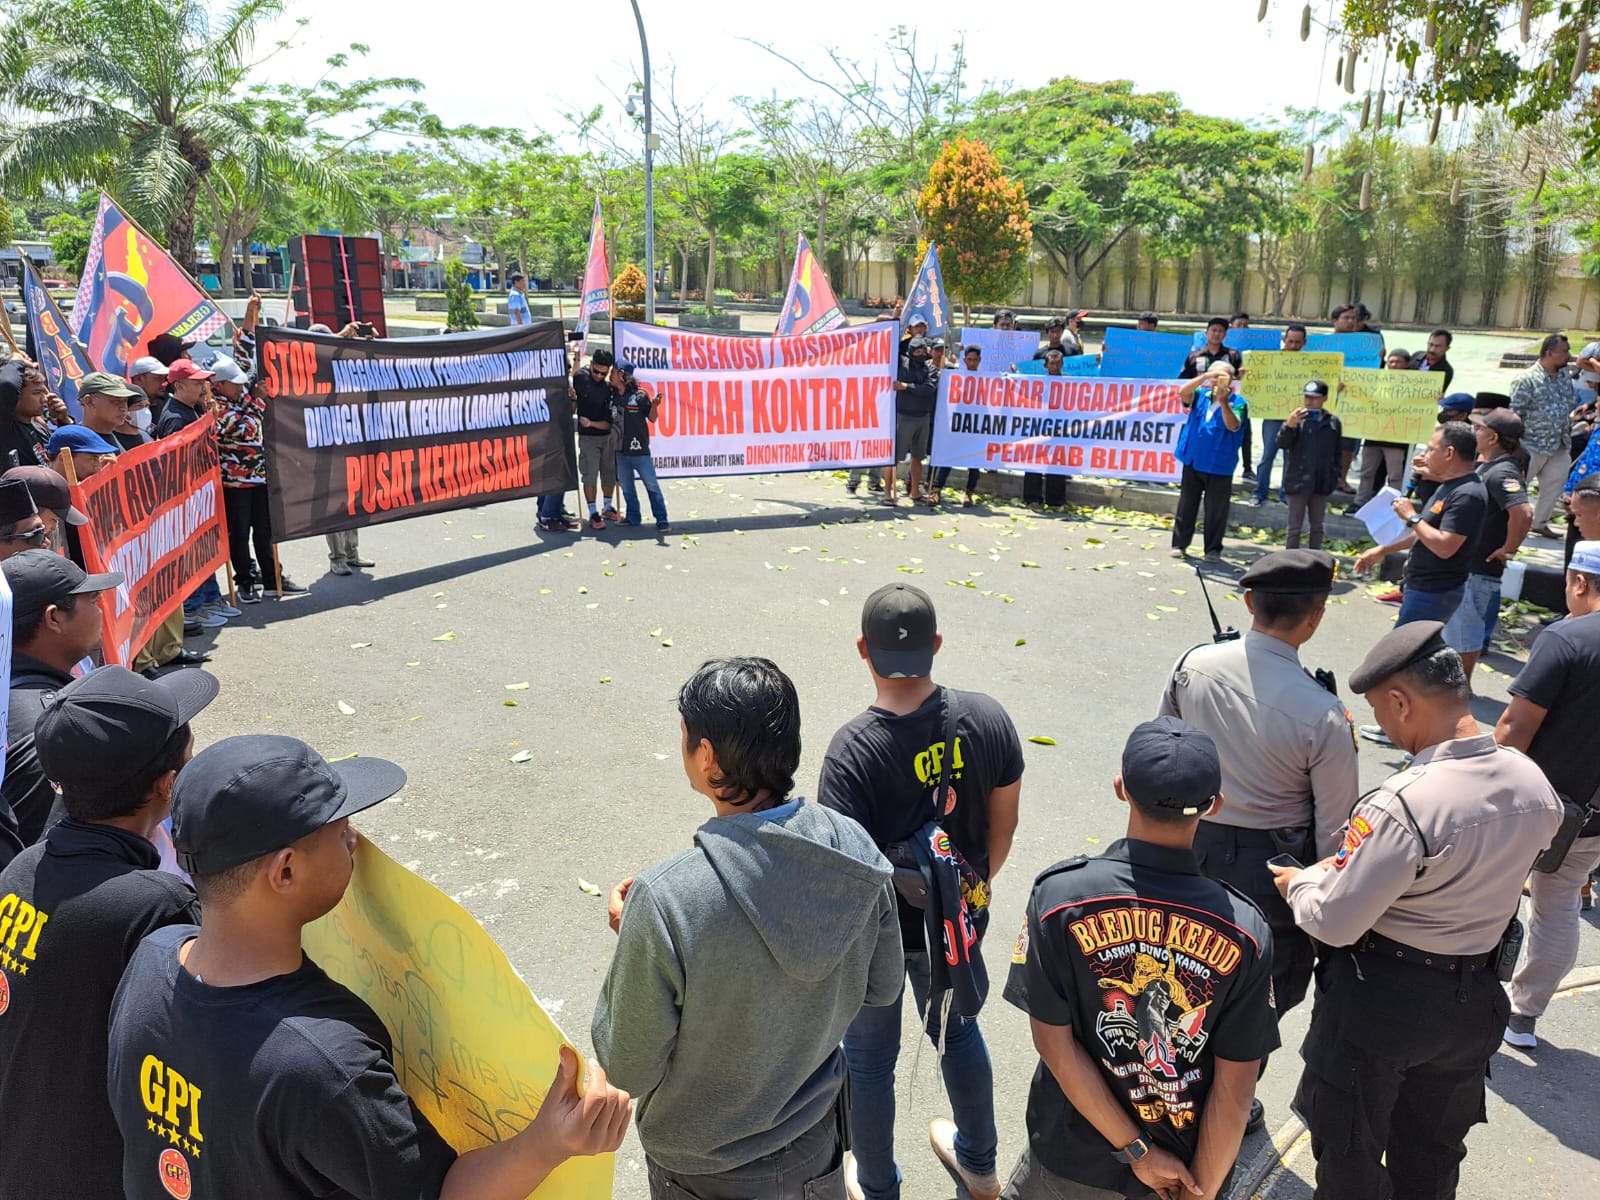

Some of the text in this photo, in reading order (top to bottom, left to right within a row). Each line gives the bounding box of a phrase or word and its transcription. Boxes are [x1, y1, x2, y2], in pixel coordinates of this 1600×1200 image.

[332, 359, 399, 393] ANGGARAN
[395, 356, 436, 389] UNTUK
[433, 352, 509, 386] PEMBANGUNAN
[508, 350, 541, 378] RUMAH
[540, 348, 566, 377] SAKIT
[623, 346, 668, 369] SEGERA
[670, 333, 764, 370] EKSEKUSI
[780, 330, 892, 367] KOSONGKAN
[948, 375, 1043, 410] BONGKAR
[1049, 381, 1133, 413] DUGAAN
[304, 388, 550, 448] DIDUGA HANYA MENJADI LADANG BISNIS
[951, 412, 1175, 444] DALAM PENGELOLAAN ASET
[1342, 414, 1422, 441] PDAM
[346, 435, 531, 515] PUSAT KEKUASAAN
[652, 455, 680, 469] ABATAN
[681, 455, 702, 468] WAKIL
[703, 455, 728, 468] BUPATI
[728, 453, 745, 466] YANG
[745, 443, 806, 465] DIKONTRAK
[807, 442, 828, 463] 294
[829, 441, 852, 462] JUTA
[860, 439, 893, 459] TAHUN
[985, 442, 1176, 474] PEMKAB BLITAR
[124, 447, 187, 526] RUMAH
[149, 504, 185, 569] WAKIL
[914, 737, 964, 784] GPI
[0, 893, 48, 960] GPI
[1069, 908, 1242, 975] BLEDUG KELUD
[1097, 942, 1211, 980] LASKAR BUNG KARNO
[140, 1055, 204, 1142] GPI
[165, 1162, 188, 1185] GPI
